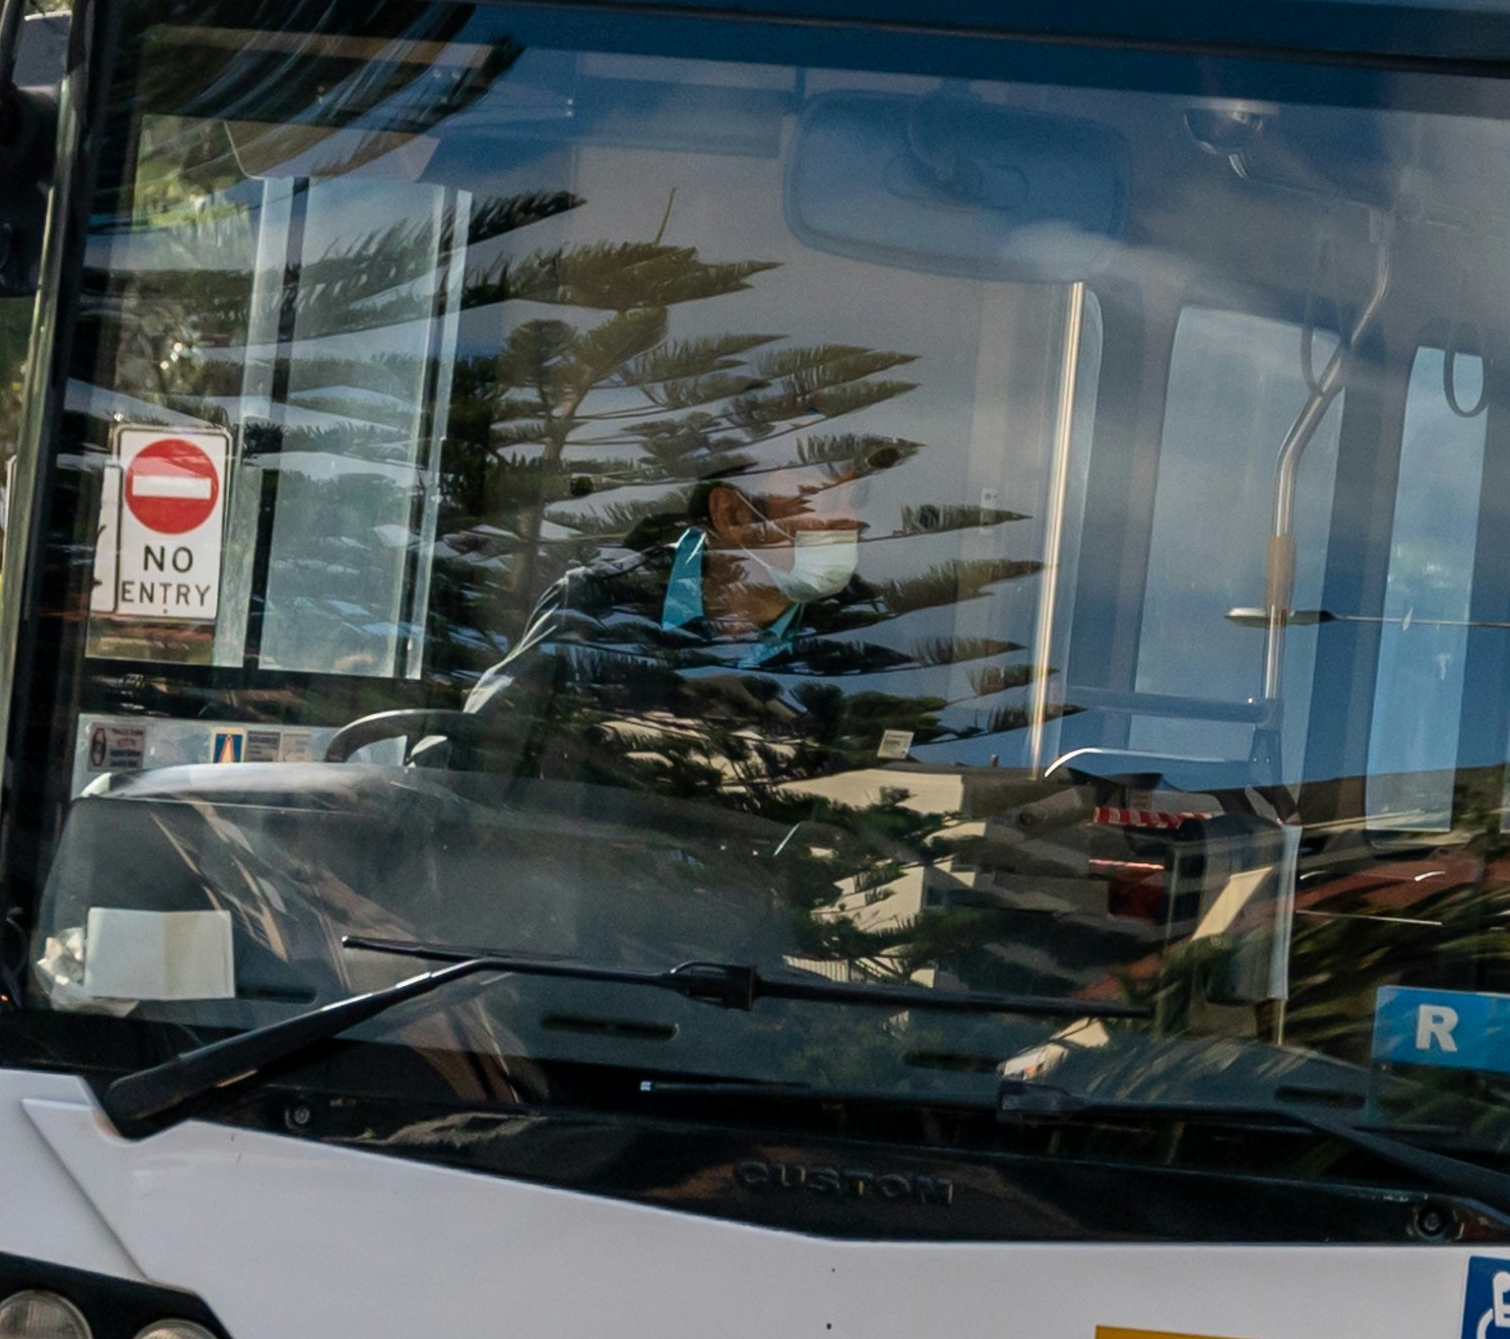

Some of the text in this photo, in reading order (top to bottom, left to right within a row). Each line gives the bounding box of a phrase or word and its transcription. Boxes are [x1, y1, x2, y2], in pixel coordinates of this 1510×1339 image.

[143, 544, 194, 573] NO
[120, 580, 212, 607] ENTRY
[1415, 1003, 1460, 1053] R
